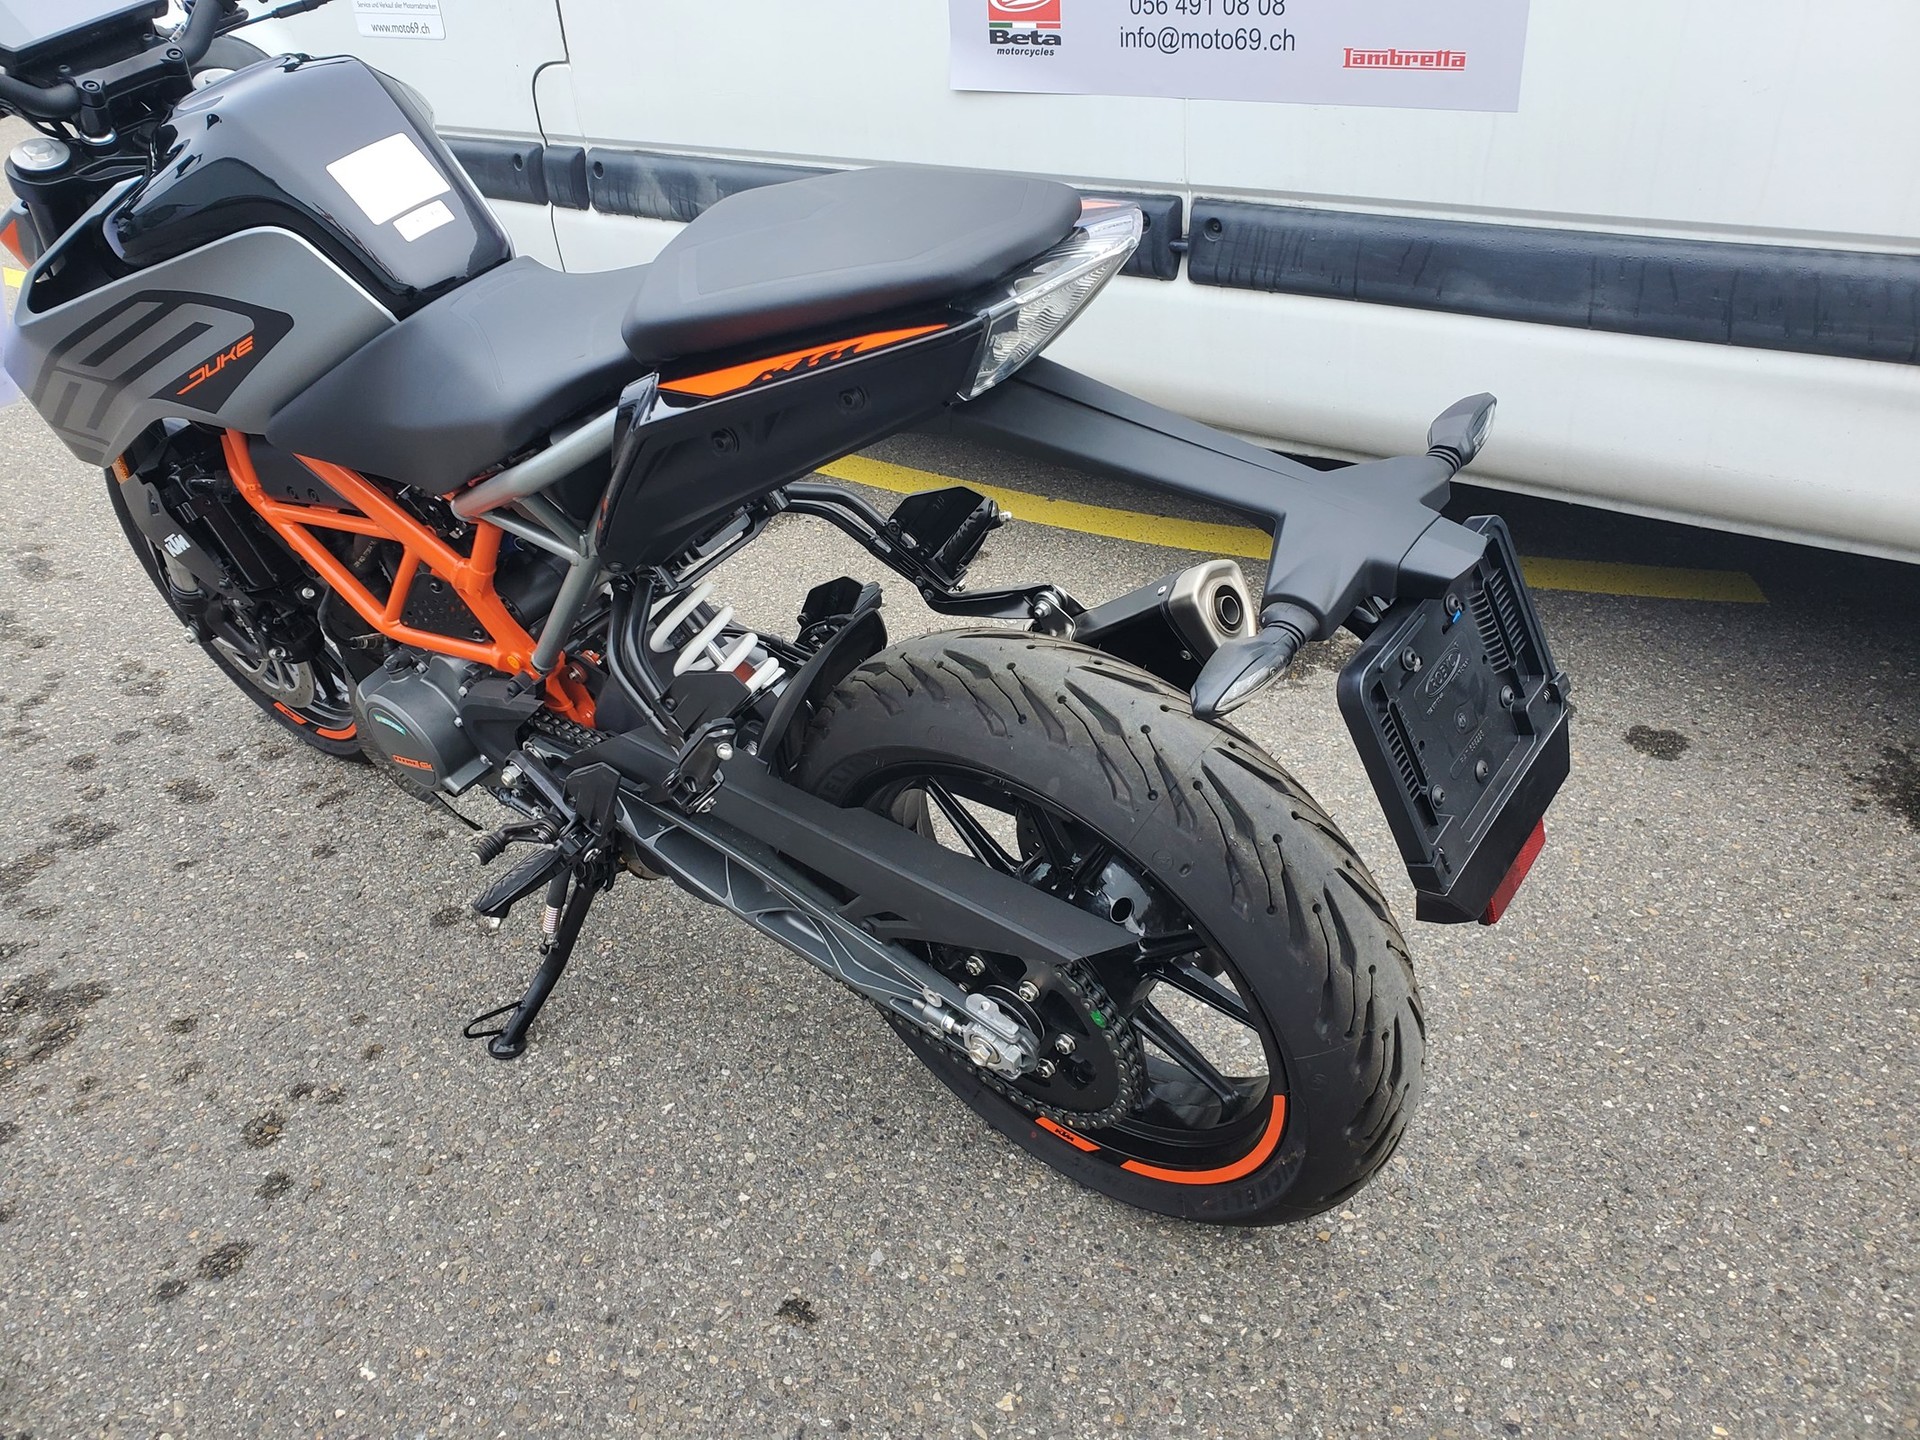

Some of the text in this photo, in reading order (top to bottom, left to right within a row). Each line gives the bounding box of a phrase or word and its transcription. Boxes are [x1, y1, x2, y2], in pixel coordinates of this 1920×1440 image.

[1130, 0, 1286, 16] 056 491 08 08
[371, 22, 431, 34] www.moto69.ch
[989, 29, 1061, 46] Beta
[1119, 26, 1296, 54] info@moto69.ch
[997, 47, 1055, 57] motorcycles
[1343, 47, 1466, 71] Lambretta
[176, 334, 254, 395] DUKE
[163, 533, 191, 558] KTM
[1054, 1128, 1075, 1142] KTM
